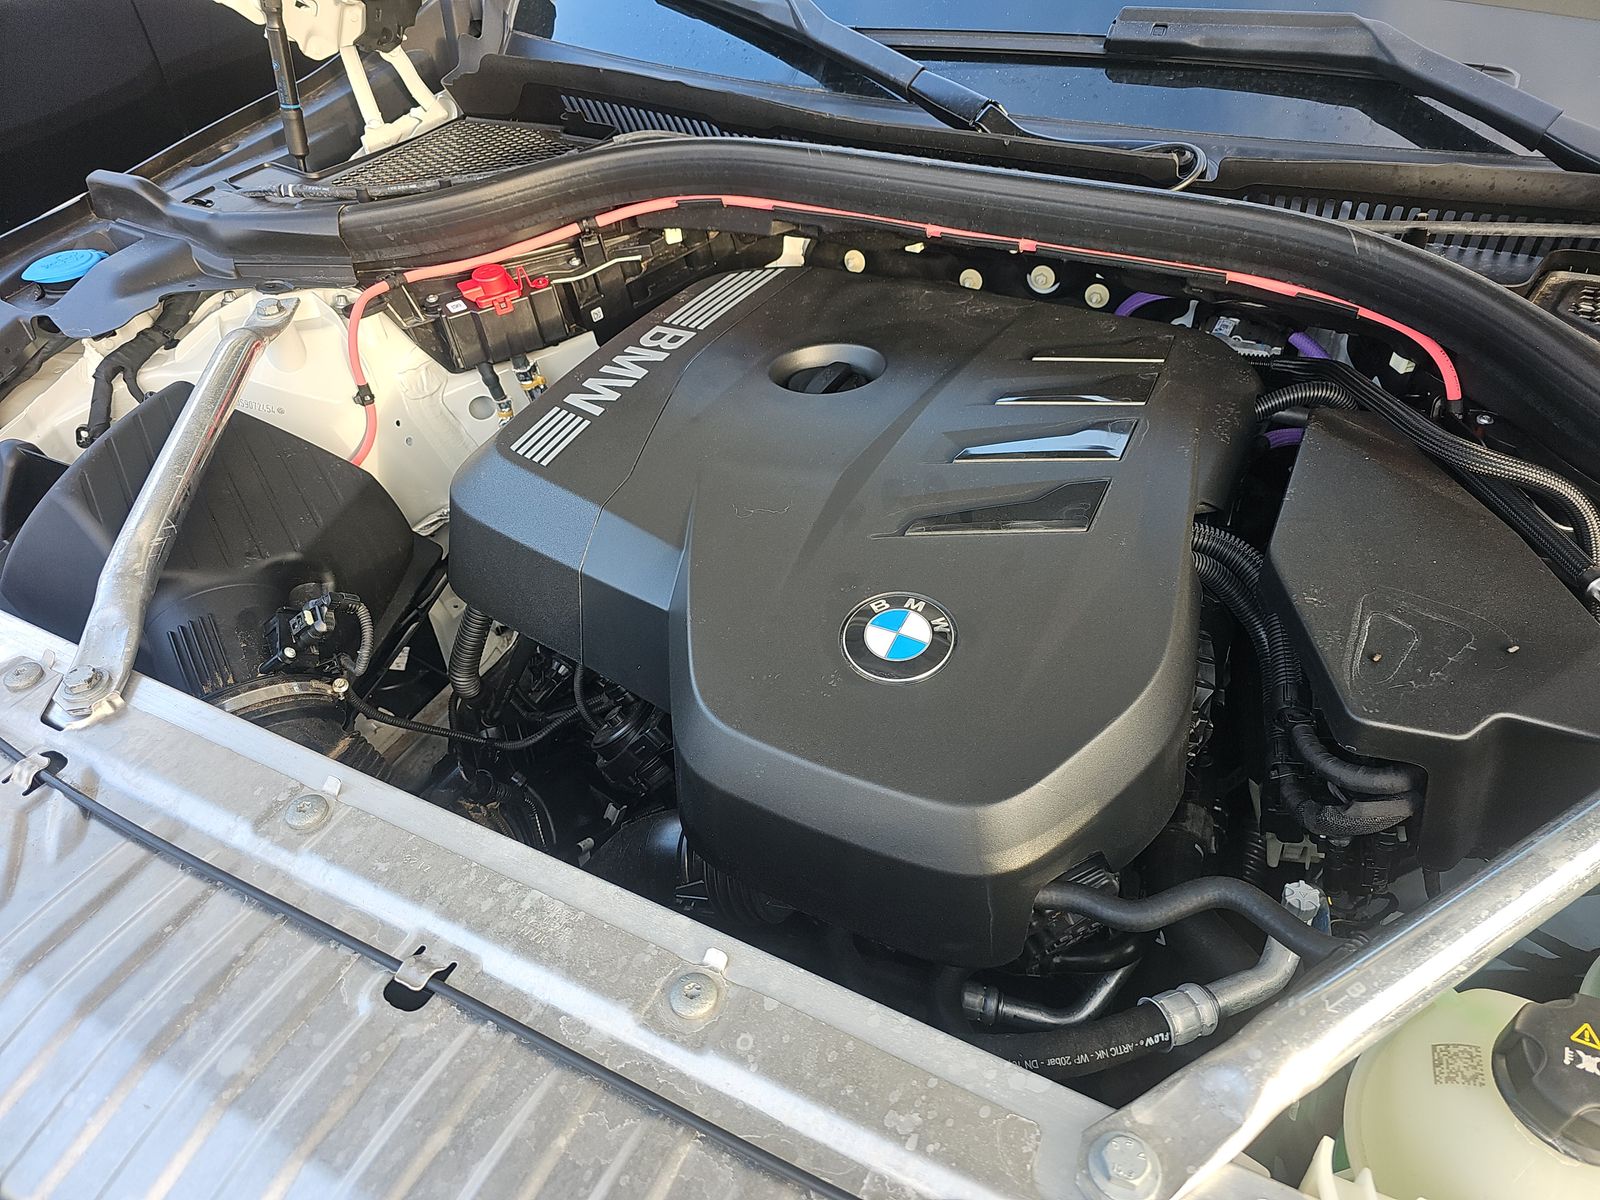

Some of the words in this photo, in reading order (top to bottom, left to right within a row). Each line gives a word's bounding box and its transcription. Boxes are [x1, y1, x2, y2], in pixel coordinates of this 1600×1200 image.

[563, 325, 697, 417] BMW
[869, 598, 951, 632] BMW
[1095, 1050, 1110, 1060] NK
[1111, 1042, 1134, 1057] ARTIC
[1024, 1060, 1039, 1070] DN
[1047, 1055, 1072, 1067] 20bar
[1074, 1053, 1090, 1066] WP
